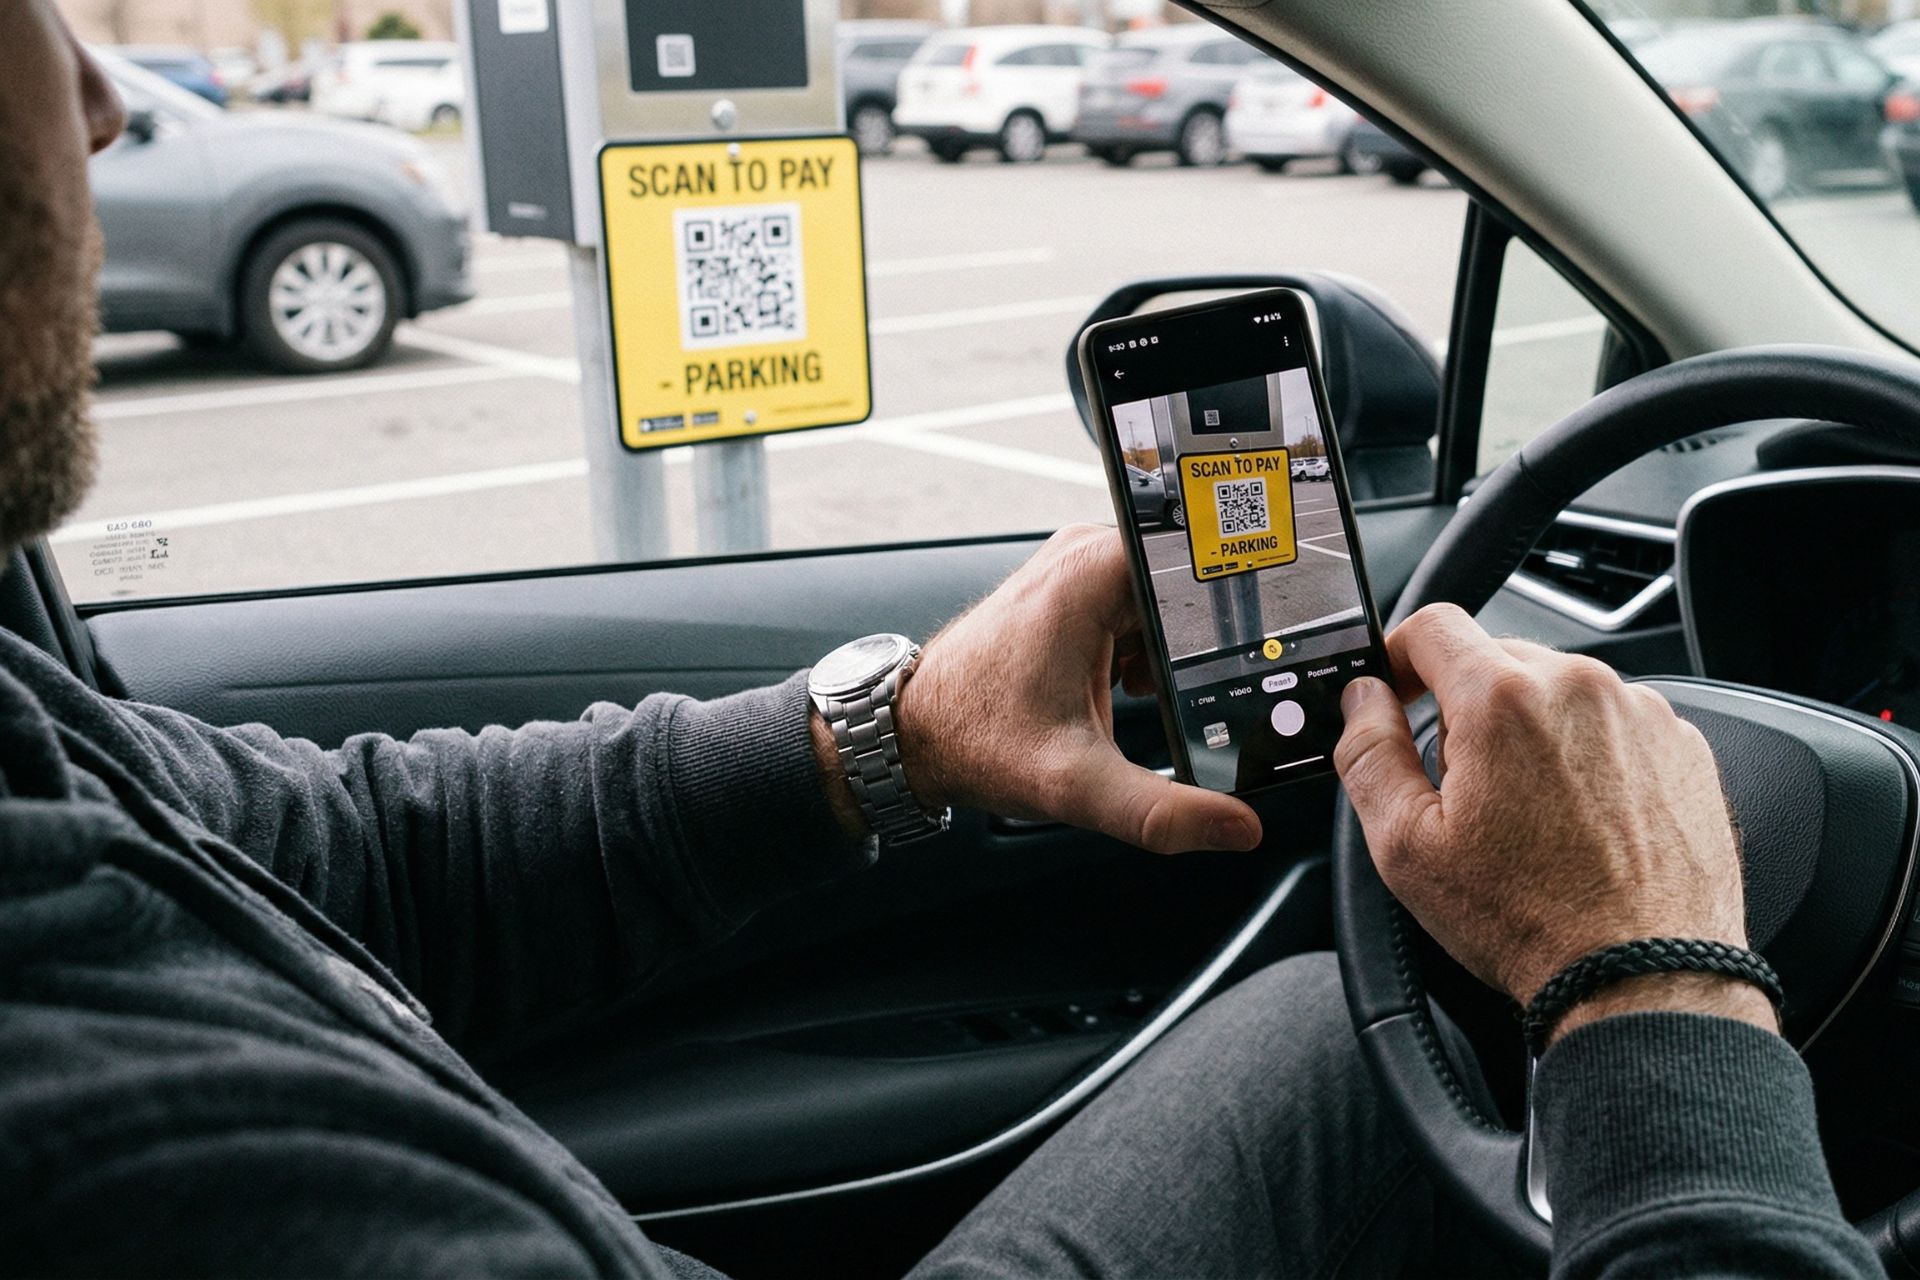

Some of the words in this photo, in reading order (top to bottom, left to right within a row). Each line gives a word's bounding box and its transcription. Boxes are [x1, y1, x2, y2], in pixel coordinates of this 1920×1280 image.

[629, 163, 716, 198] SCAN
[729, 159, 768, 192] TO
[780, 156, 834, 190] PAY
[685, 351, 823, 395] PARKING
[1190, 460, 1232, 478] SCAN
[1234, 458, 1253, 474] TO
[1256, 456, 1280, 472] PAY
[1220, 535, 1278, 557] PARKING
